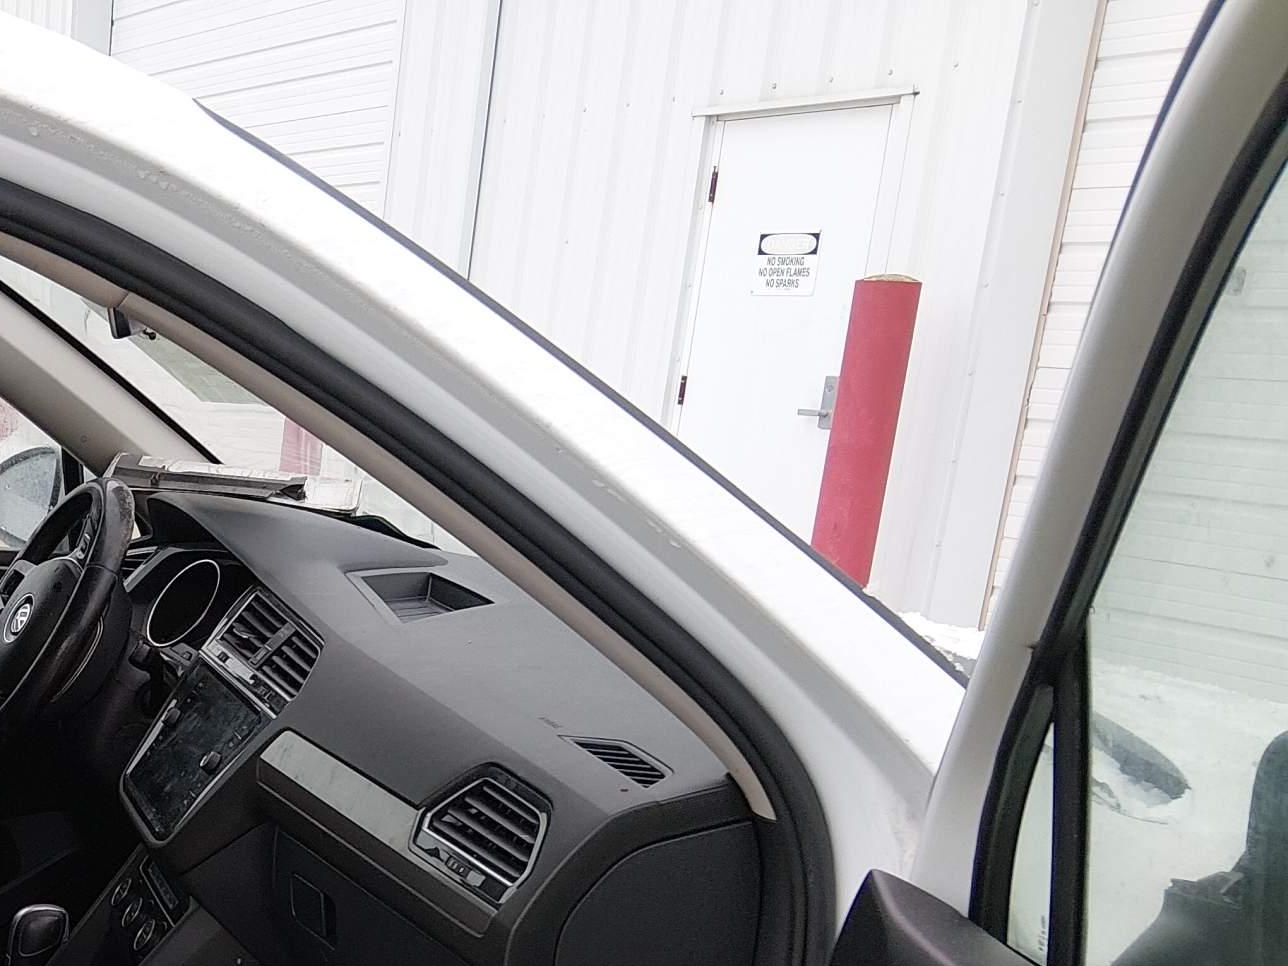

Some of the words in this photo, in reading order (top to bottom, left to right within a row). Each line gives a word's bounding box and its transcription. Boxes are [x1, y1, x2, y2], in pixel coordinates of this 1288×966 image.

[767, 256, 776, 266] NO
[777, 256, 805, 266] SMOKING
[758, 267, 768, 277] NO
[768, 267, 785, 277] OPEN
[786, 267, 810, 277] FLAMES
[765, 278, 775, 288] NO
[775, 278, 800, 288] SPARKS
